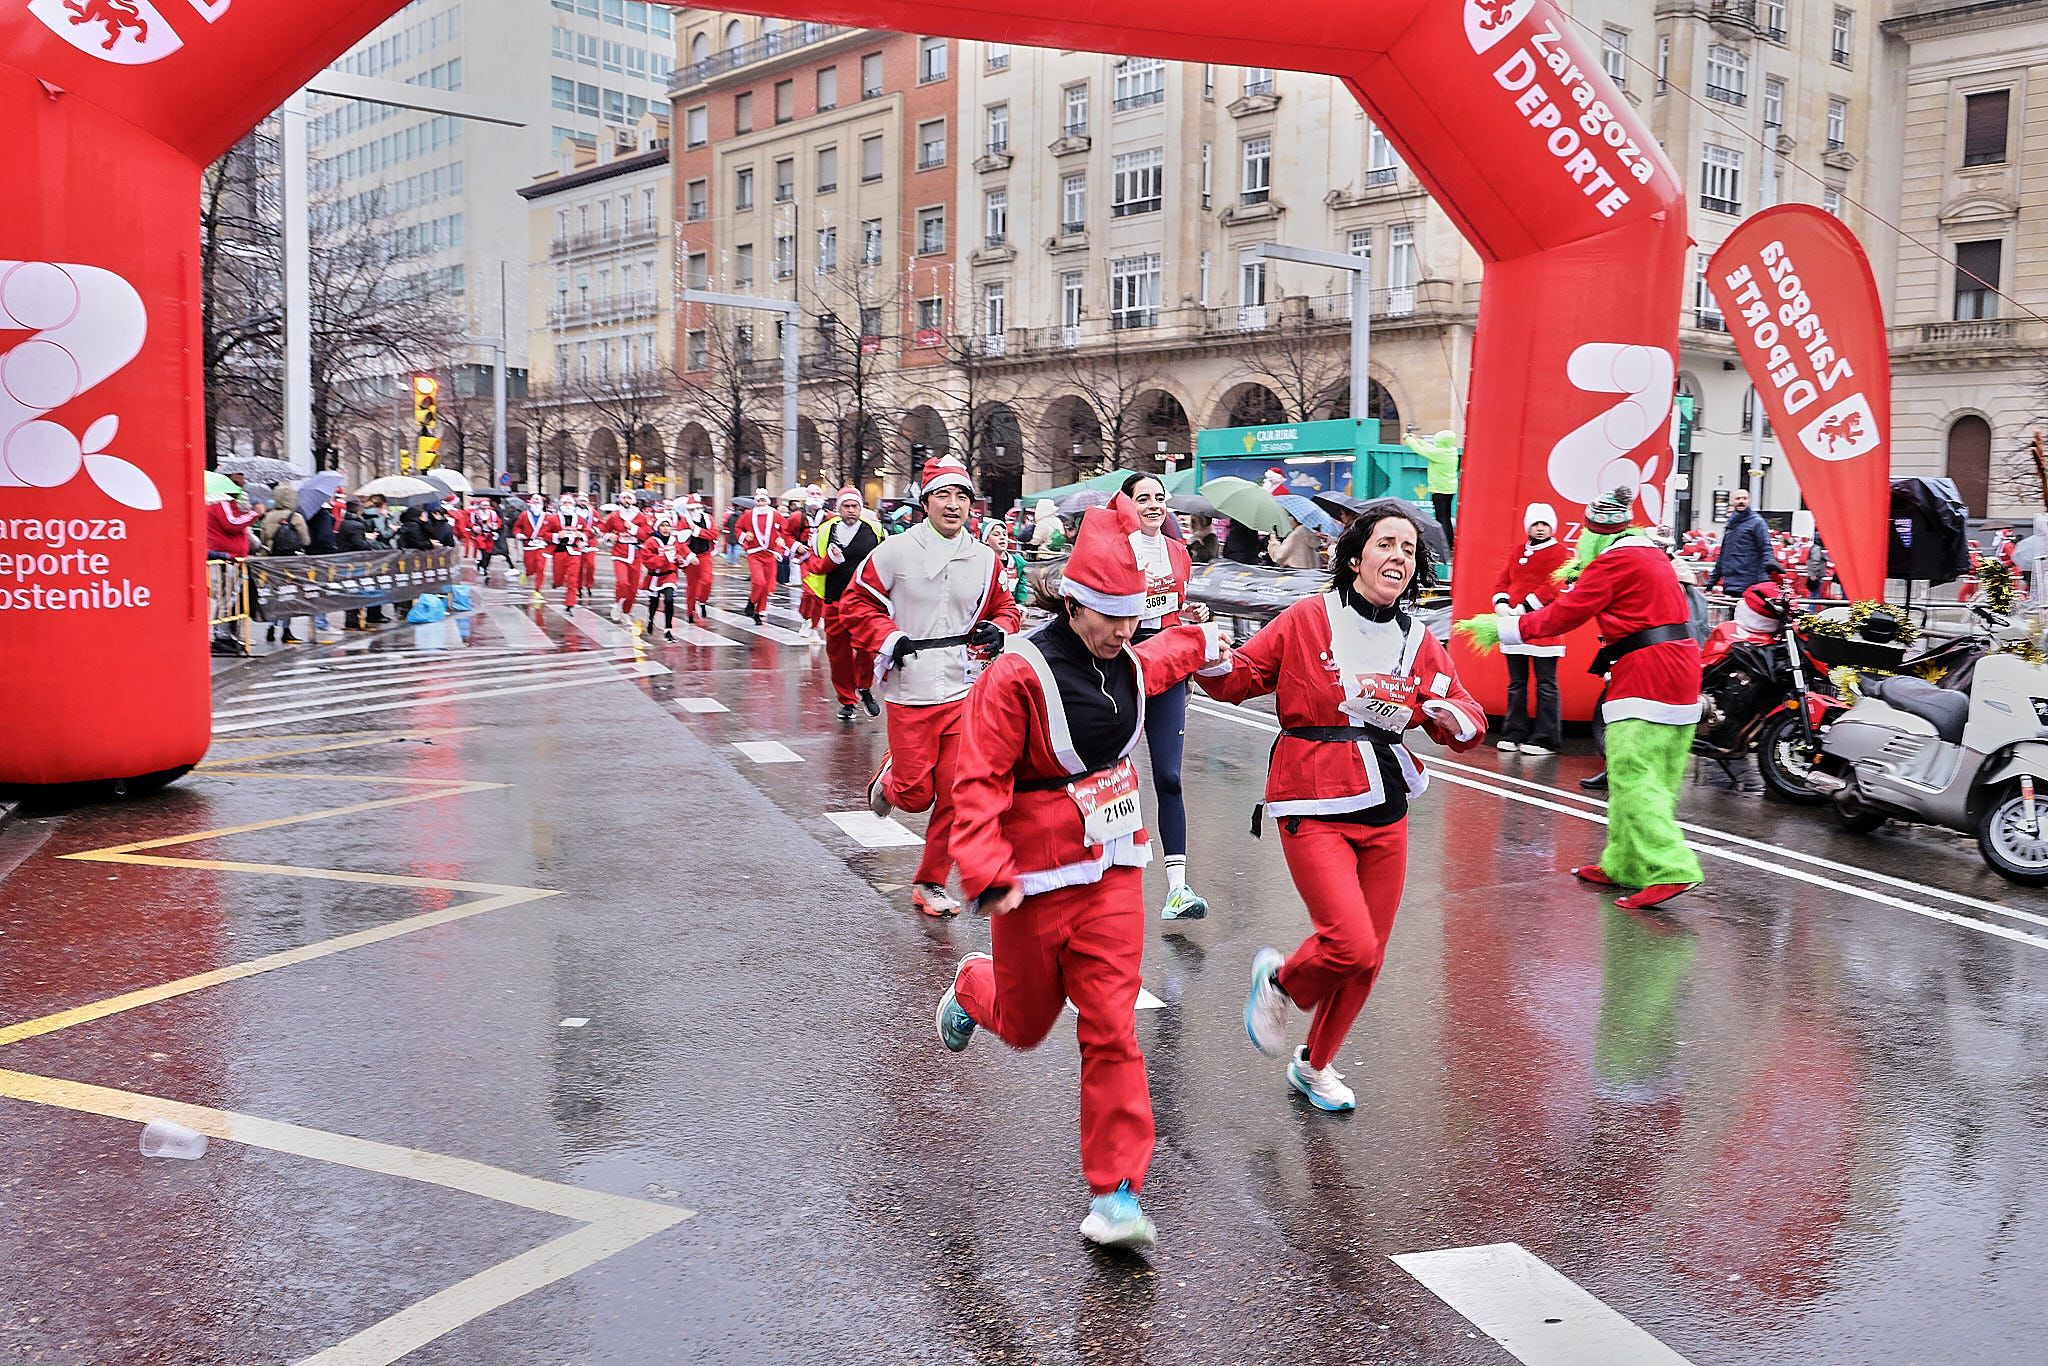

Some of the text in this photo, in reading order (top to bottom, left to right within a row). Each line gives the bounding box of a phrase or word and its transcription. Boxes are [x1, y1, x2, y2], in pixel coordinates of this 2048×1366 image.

[1530, 19, 1654, 185] Zaragoza
[1493, 48, 1631, 218] DEPORTE
[0, 548, 110, 583] eporte
[0, 579, 151, 610] ostenible
[1145, 595, 1167, 608] 3689
[1365, 700, 1400, 718] 2167
